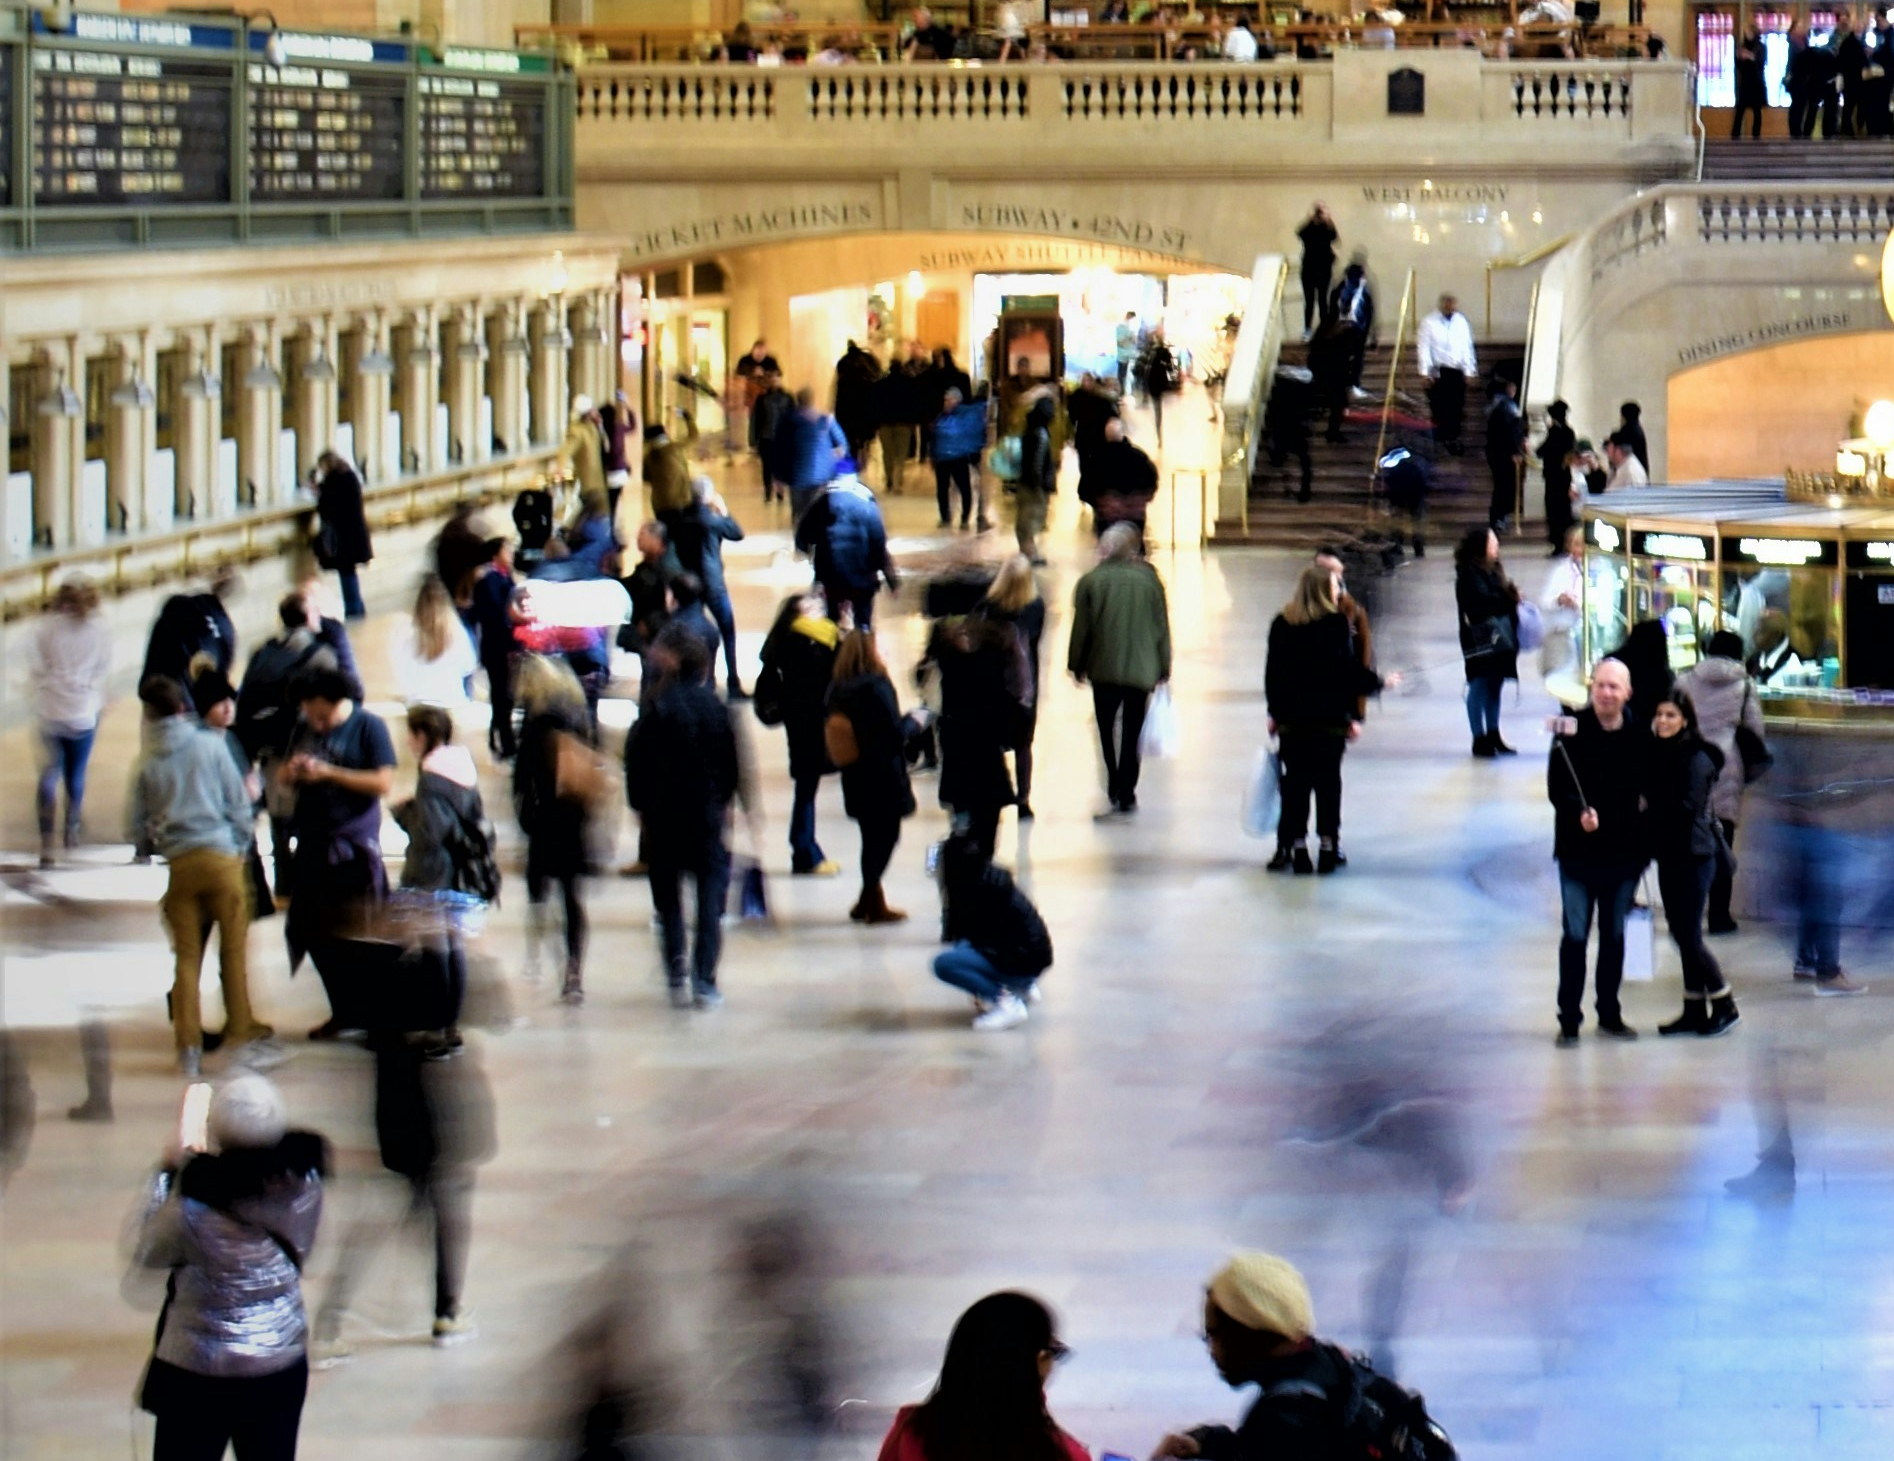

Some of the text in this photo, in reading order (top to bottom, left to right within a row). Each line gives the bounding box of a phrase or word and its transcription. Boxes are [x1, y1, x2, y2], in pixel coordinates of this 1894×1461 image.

[1362, 186, 1510, 202] WEST BALCONY
[634, 201, 873, 255] TICKET MACHINES
[963, 203, 1066, 229] SUBWAY
[1160, 228, 1192, 251] ST
[920, 245, 1009, 270] SUBWAY
[1677, 312, 1851, 365] DINING CONCOURSE
